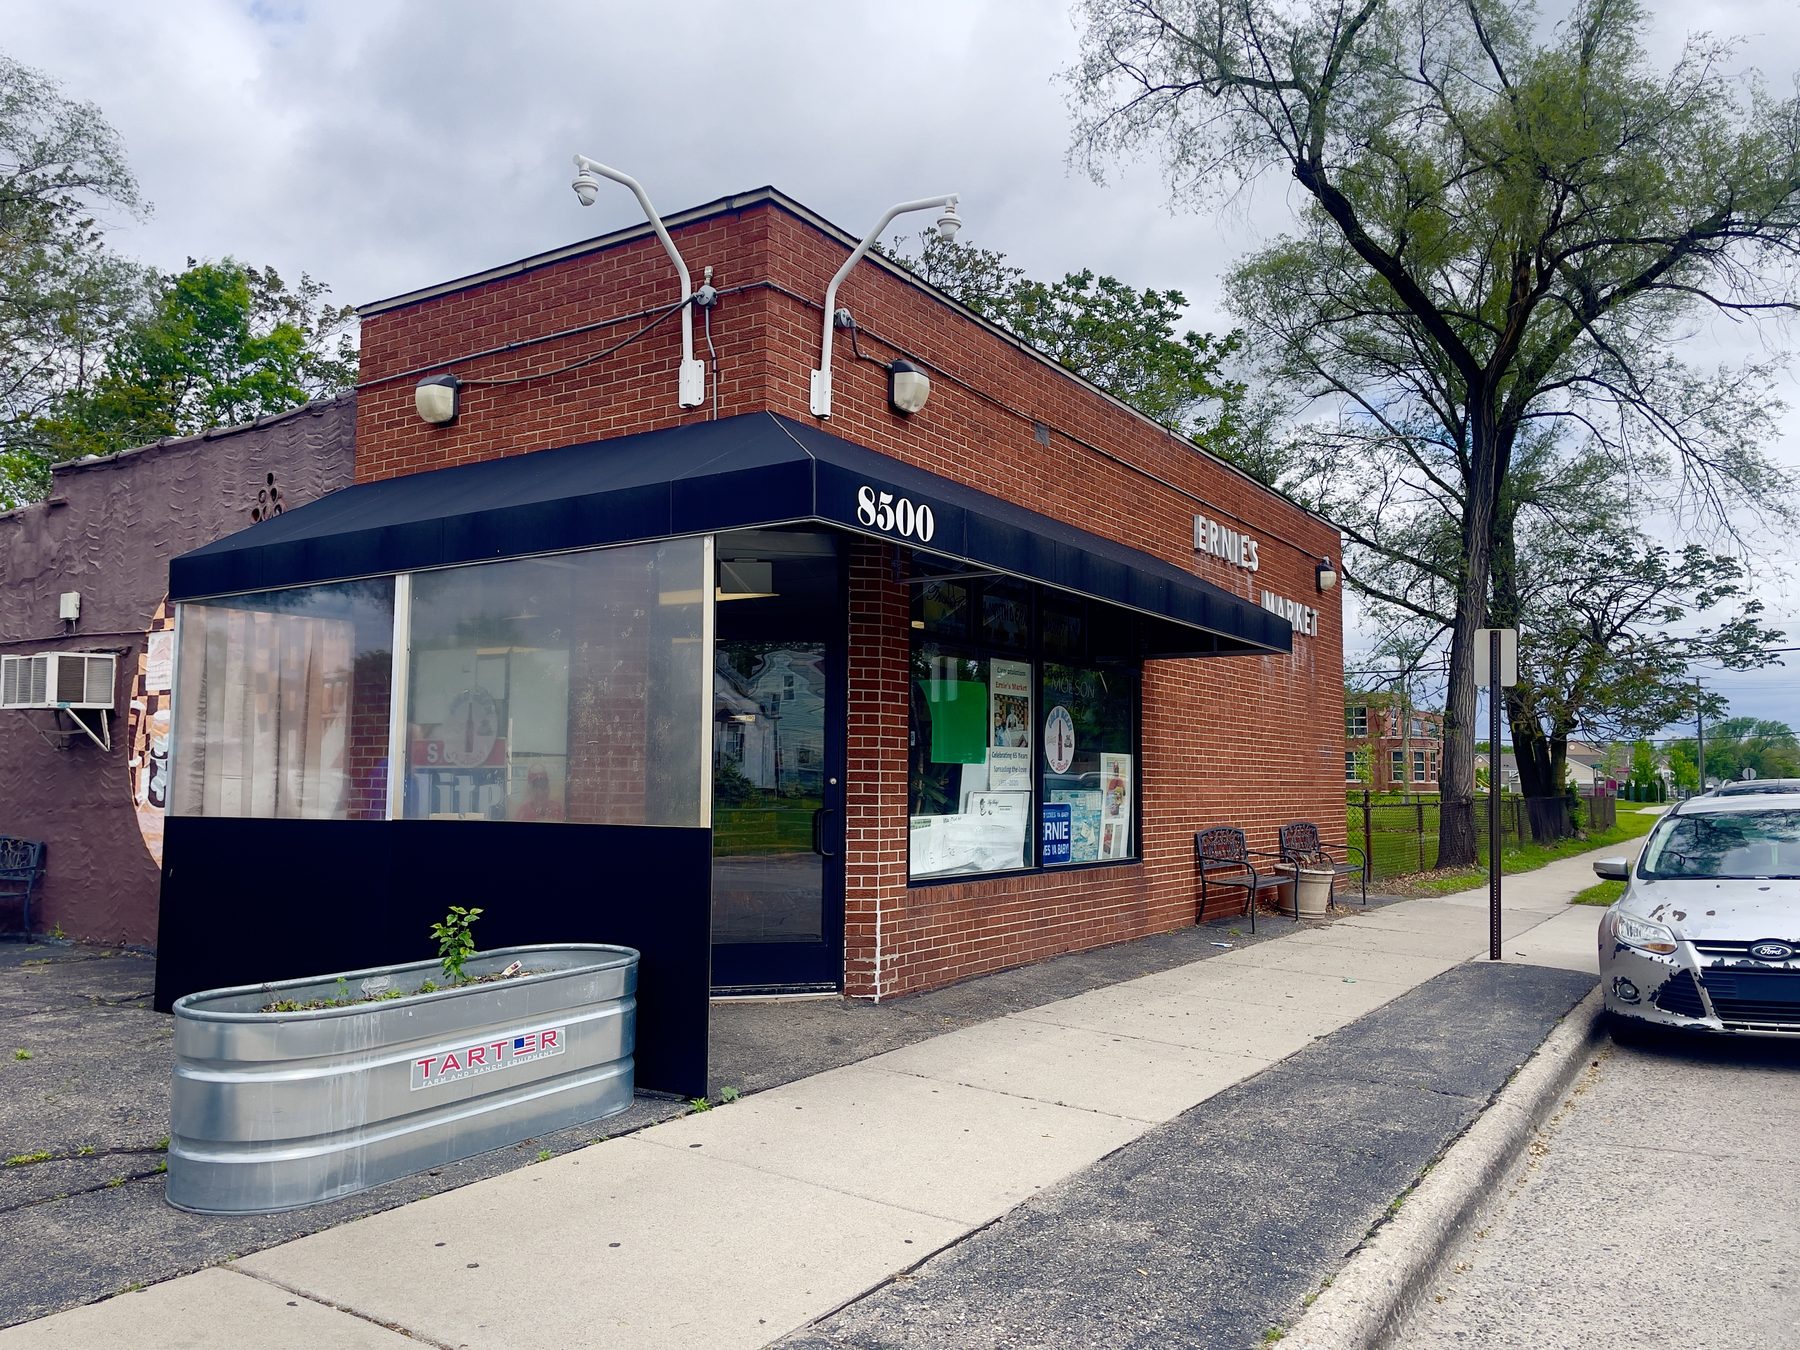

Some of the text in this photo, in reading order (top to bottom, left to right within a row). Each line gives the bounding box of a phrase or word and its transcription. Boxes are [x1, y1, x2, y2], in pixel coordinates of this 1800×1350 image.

[858, 486, 934, 542] 8500
[1761, 947, 1782, 955] Ford
[417, 1030, 558, 1078] TARTER
[422, 1051, 554, 1087] FARM AND RANCH EQUIPMENT
